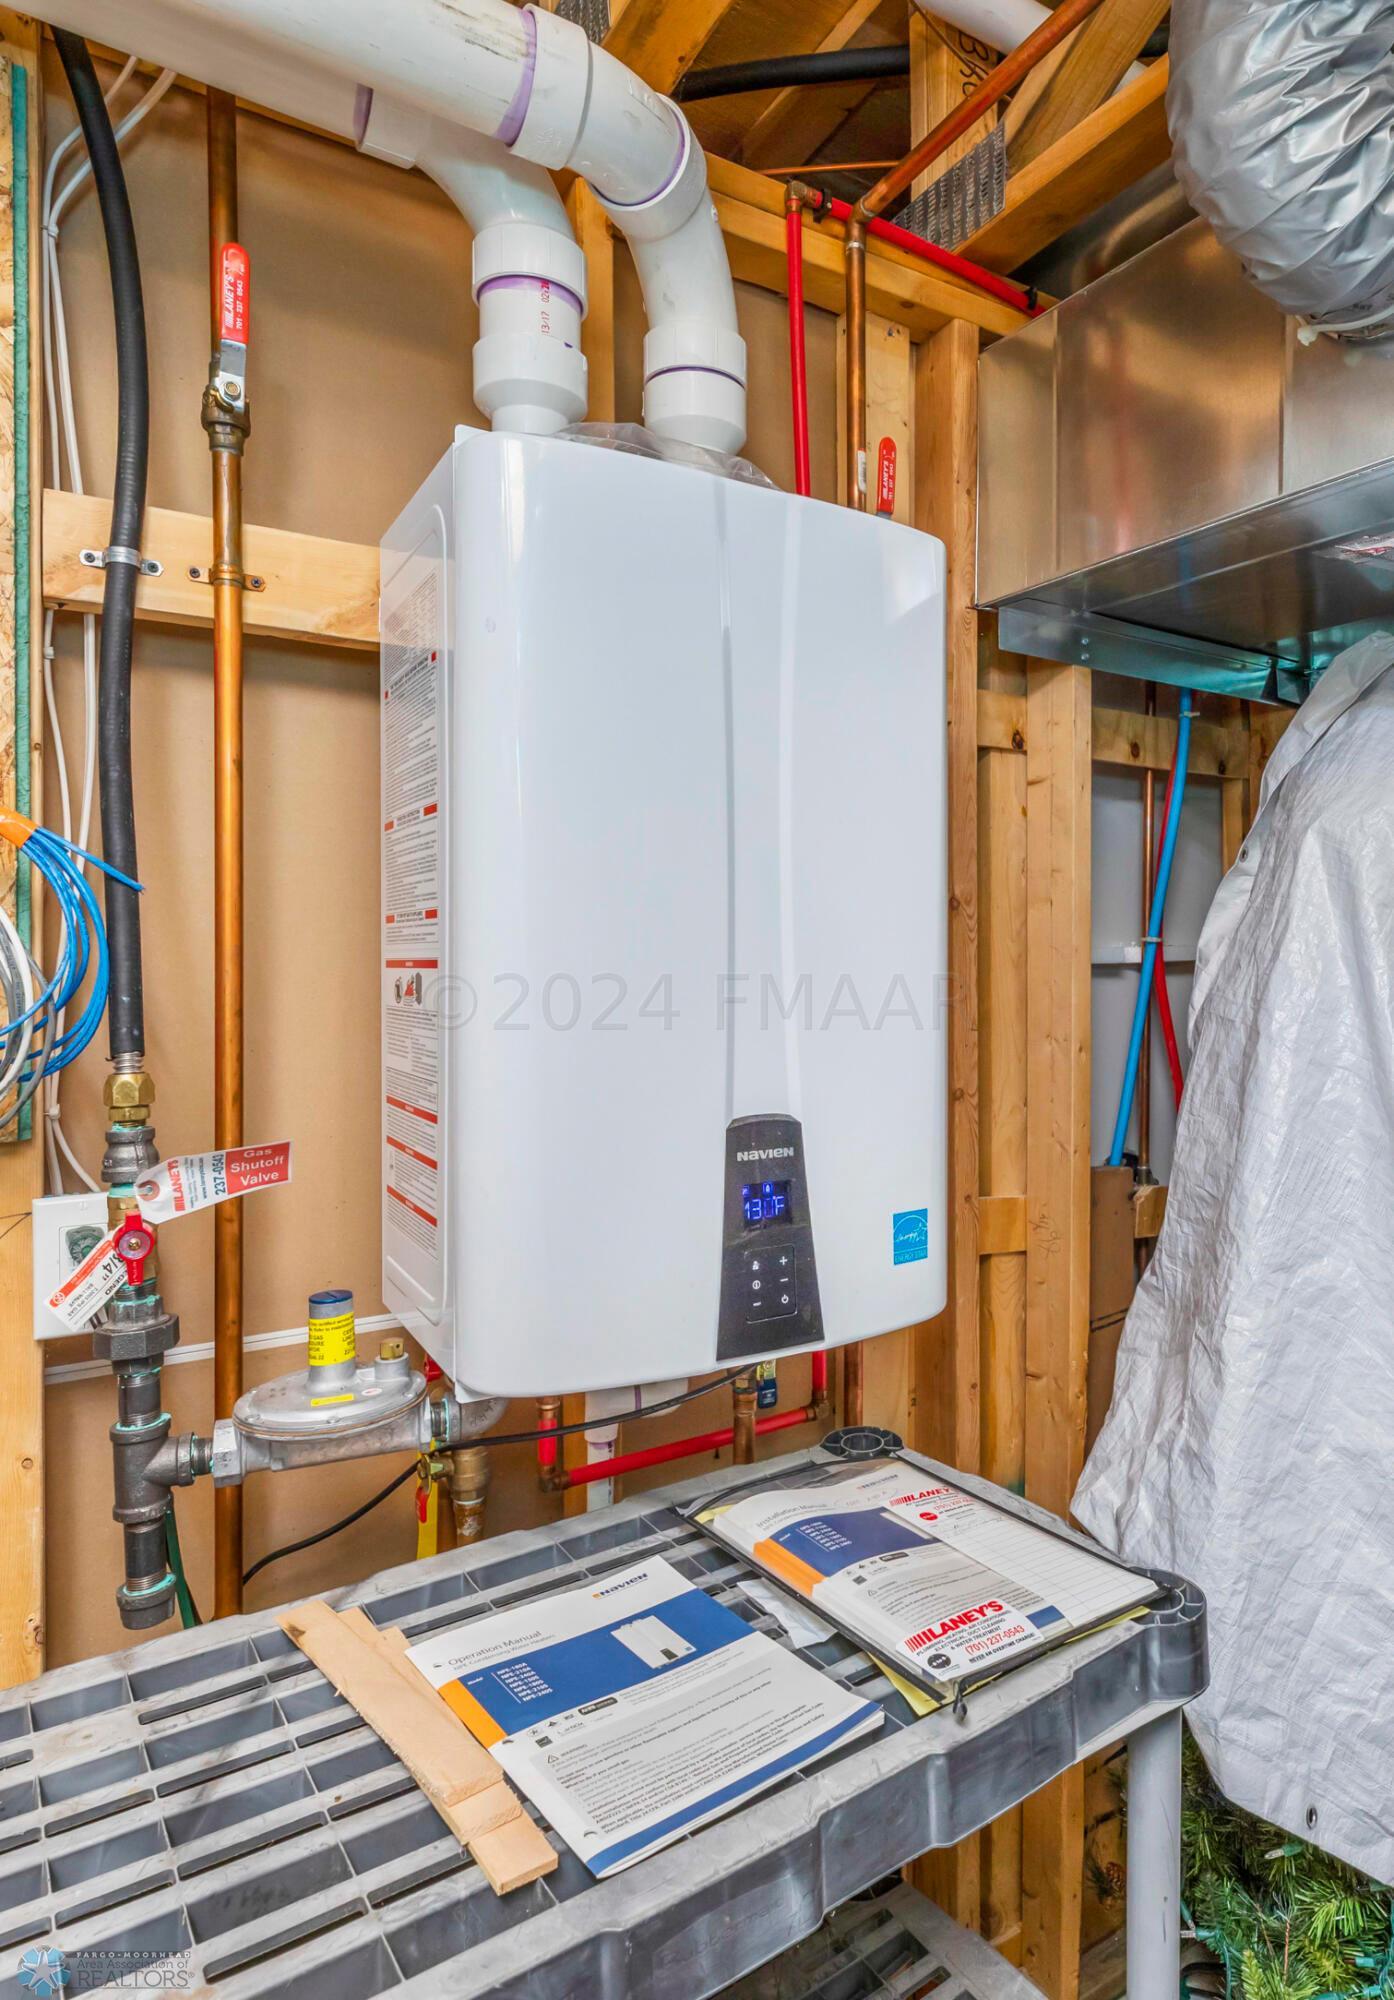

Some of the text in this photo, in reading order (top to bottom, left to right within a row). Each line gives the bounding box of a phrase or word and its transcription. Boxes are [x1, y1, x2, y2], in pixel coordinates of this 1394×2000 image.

[230, 1156, 284, 1173] Shutoff
[243, 1149, 272, 1158] Gas
[212, 1154, 225, 1195] 237-0543
[240, 1172, 279, 1186] Valve
[927, 1600, 1003, 1640] LANEY'S
[964, 1625, 1024, 1655] (701) 237-0543
[973, 1626, 1002, 1640] TREATMENT
[446, 1630, 542, 1667] Operation Manual
[968, 1653, 985, 1663] NEVER
[992, 1640, 1016, 1653] OVERTIME
